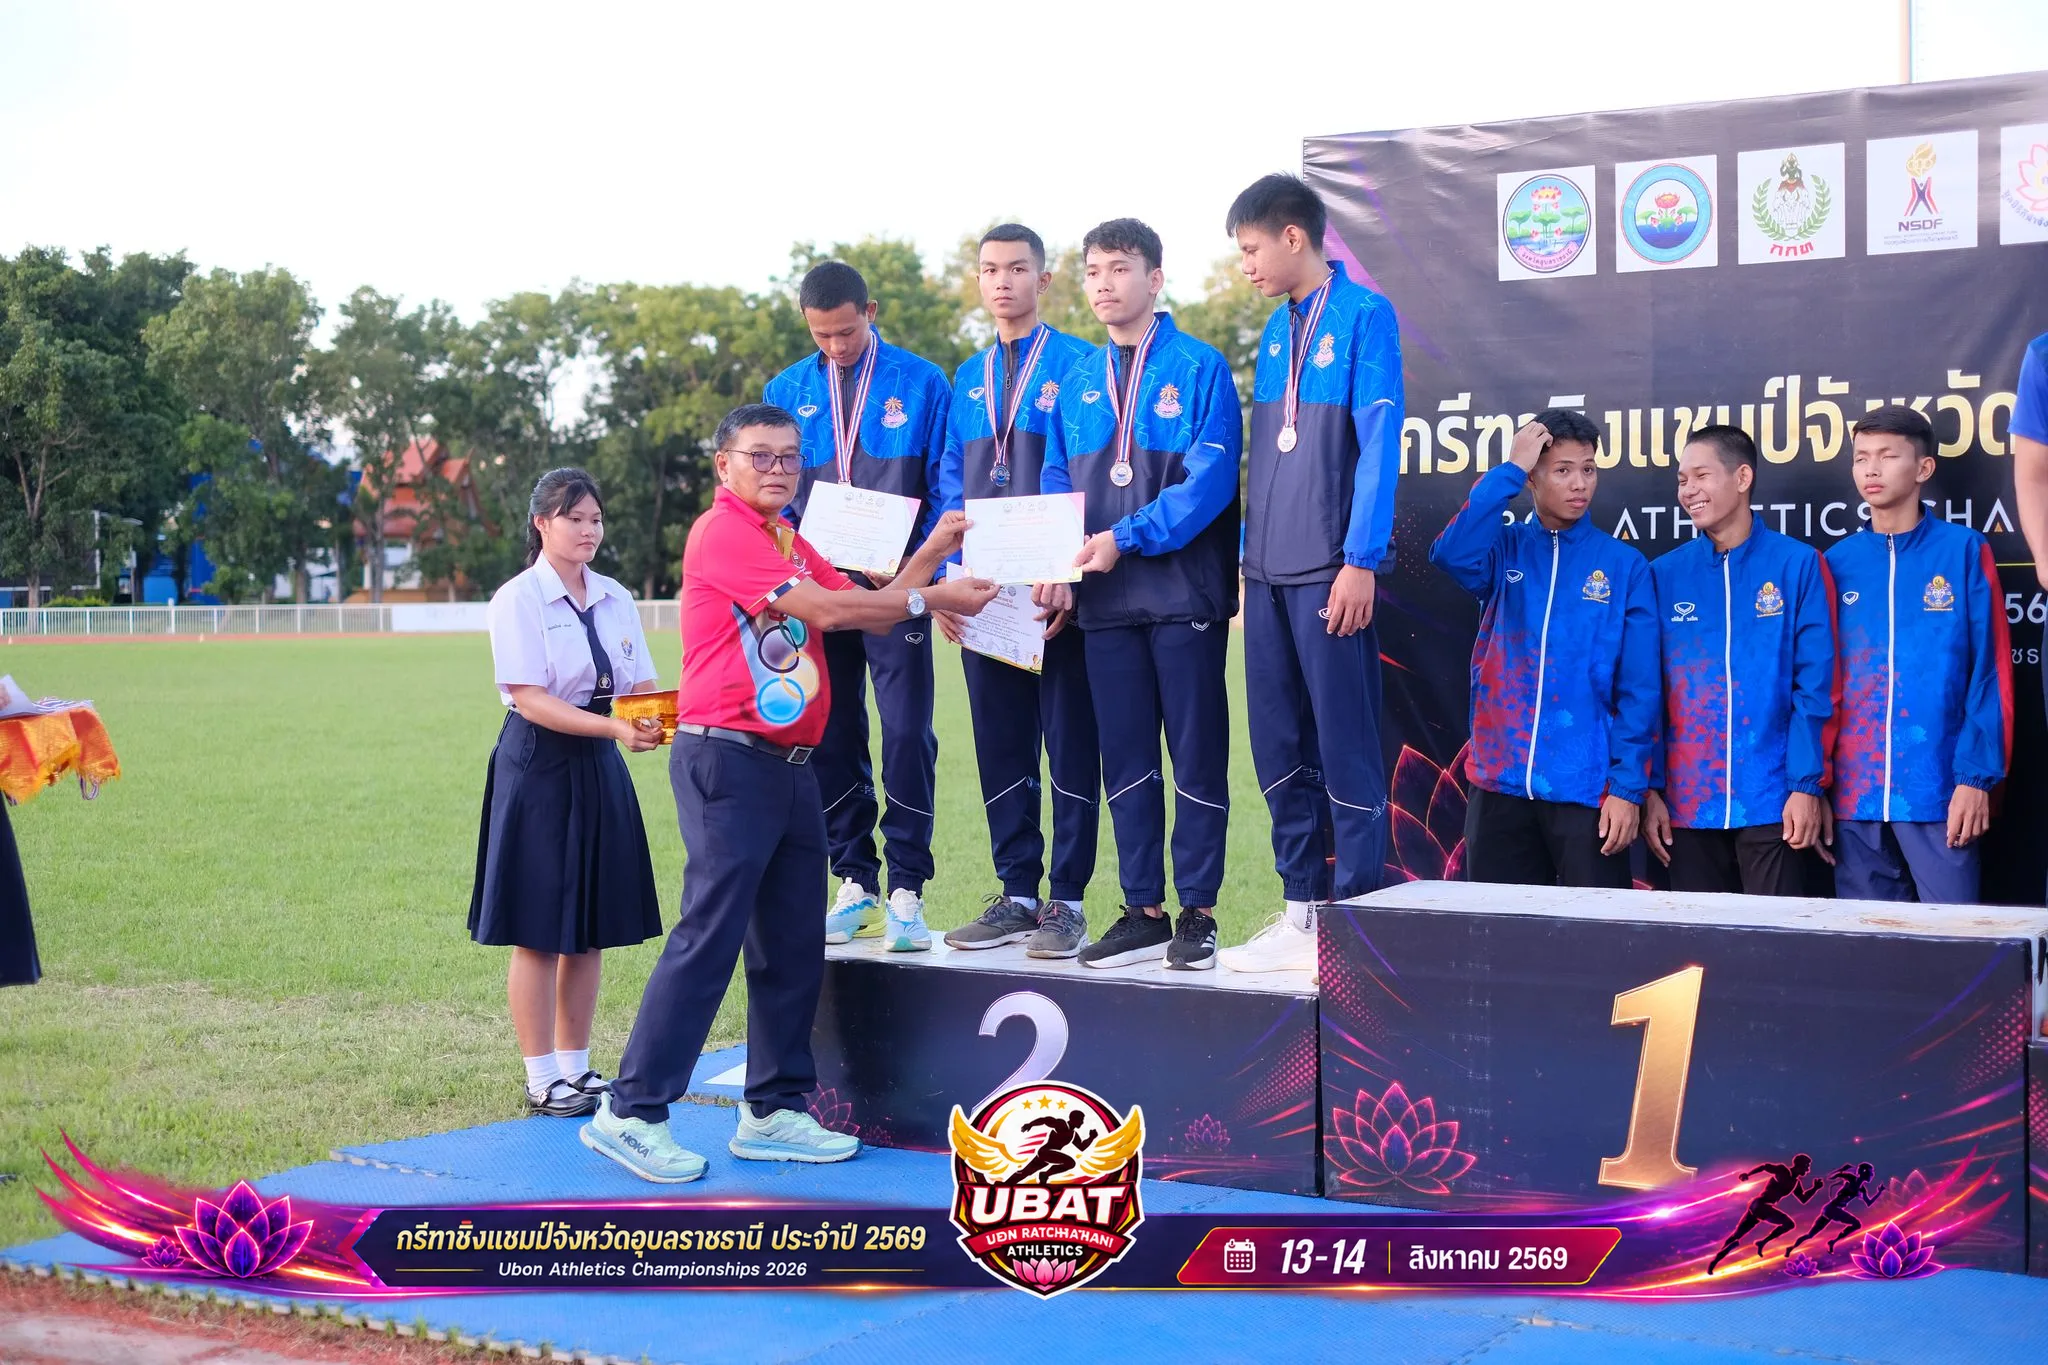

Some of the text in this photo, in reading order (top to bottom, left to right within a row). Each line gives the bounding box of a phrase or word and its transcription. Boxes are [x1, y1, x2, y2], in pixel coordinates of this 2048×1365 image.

[1898, 218, 1943, 232] NSDF
[1612, 499, 1872, 541] ATHTICS
[969, 991, 1069, 1115] 2
[1598, 965, 1704, 1191] 1
[619, 1131, 650, 1159] HOKA
